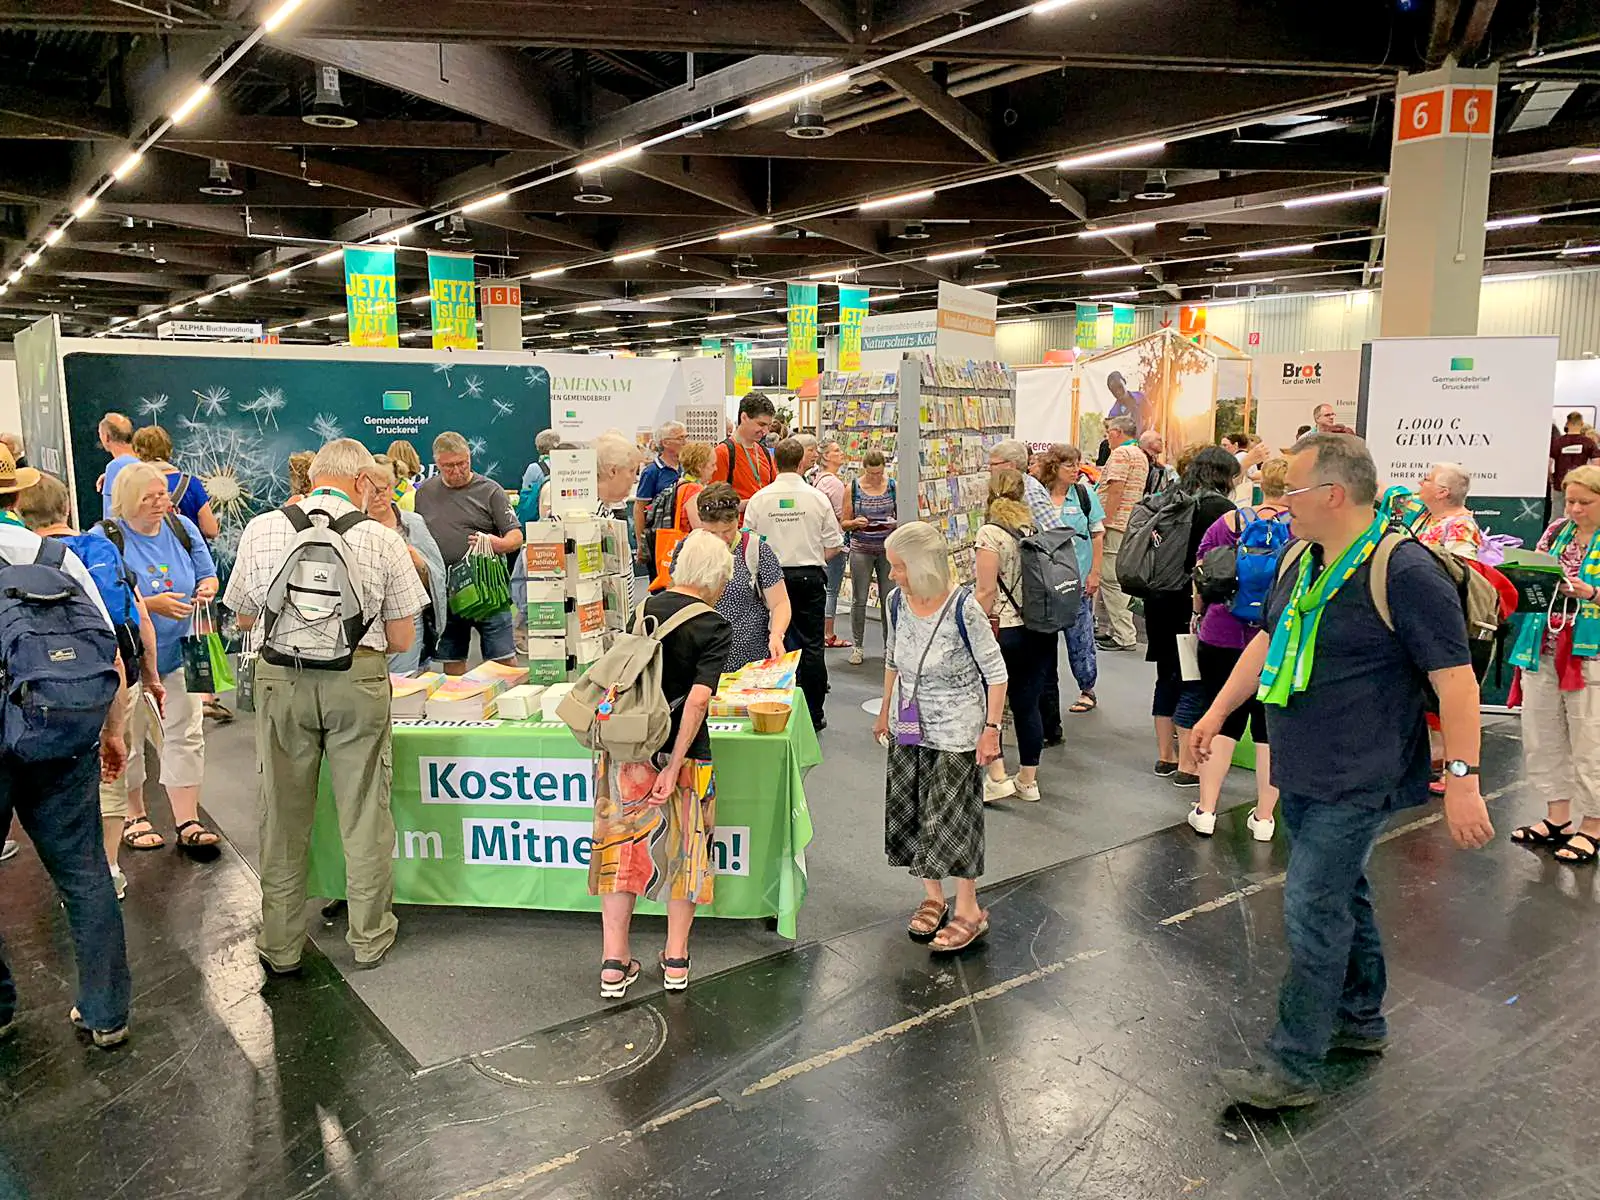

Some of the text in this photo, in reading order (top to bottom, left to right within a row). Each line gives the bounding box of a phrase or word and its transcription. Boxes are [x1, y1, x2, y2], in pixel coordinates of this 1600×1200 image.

[1413, 101, 1428, 130] 6
[1463, 97, 1479, 125] 6
[346, 274, 396, 298] JETZT
[430, 279, 476, 303] JETZT
[495, 290, 503, 302] 6
[436, 302, 454, 318] ist
[354, 314, 388, 334] ZEIT
[1188, 308, 1198, 328] 7
[180, 324, 254, 334] ALPHA Buchhandlung
[1282, 362, 1322, 378] Brot
[551, 377, 632, 393] EMEINSAM
[1431, 375, 1491, 383] Gemeindebrief
[1441, 383, 1480, 391] Druckerei
[363, 416, 429, 425] Gemeindebrief
[1396, 417, 1444, 430] 1.000
[376, 425, 419, 434] Druckerei
[1395, 433, 1494, 446] GEWINNEN
[1391, 460, 1407, 469] FÜR
[1409, 461, 1424, 469] EIN
[1390, 471, 1418, 479] IHRER
[429, 762, 595, 802] Kosten
